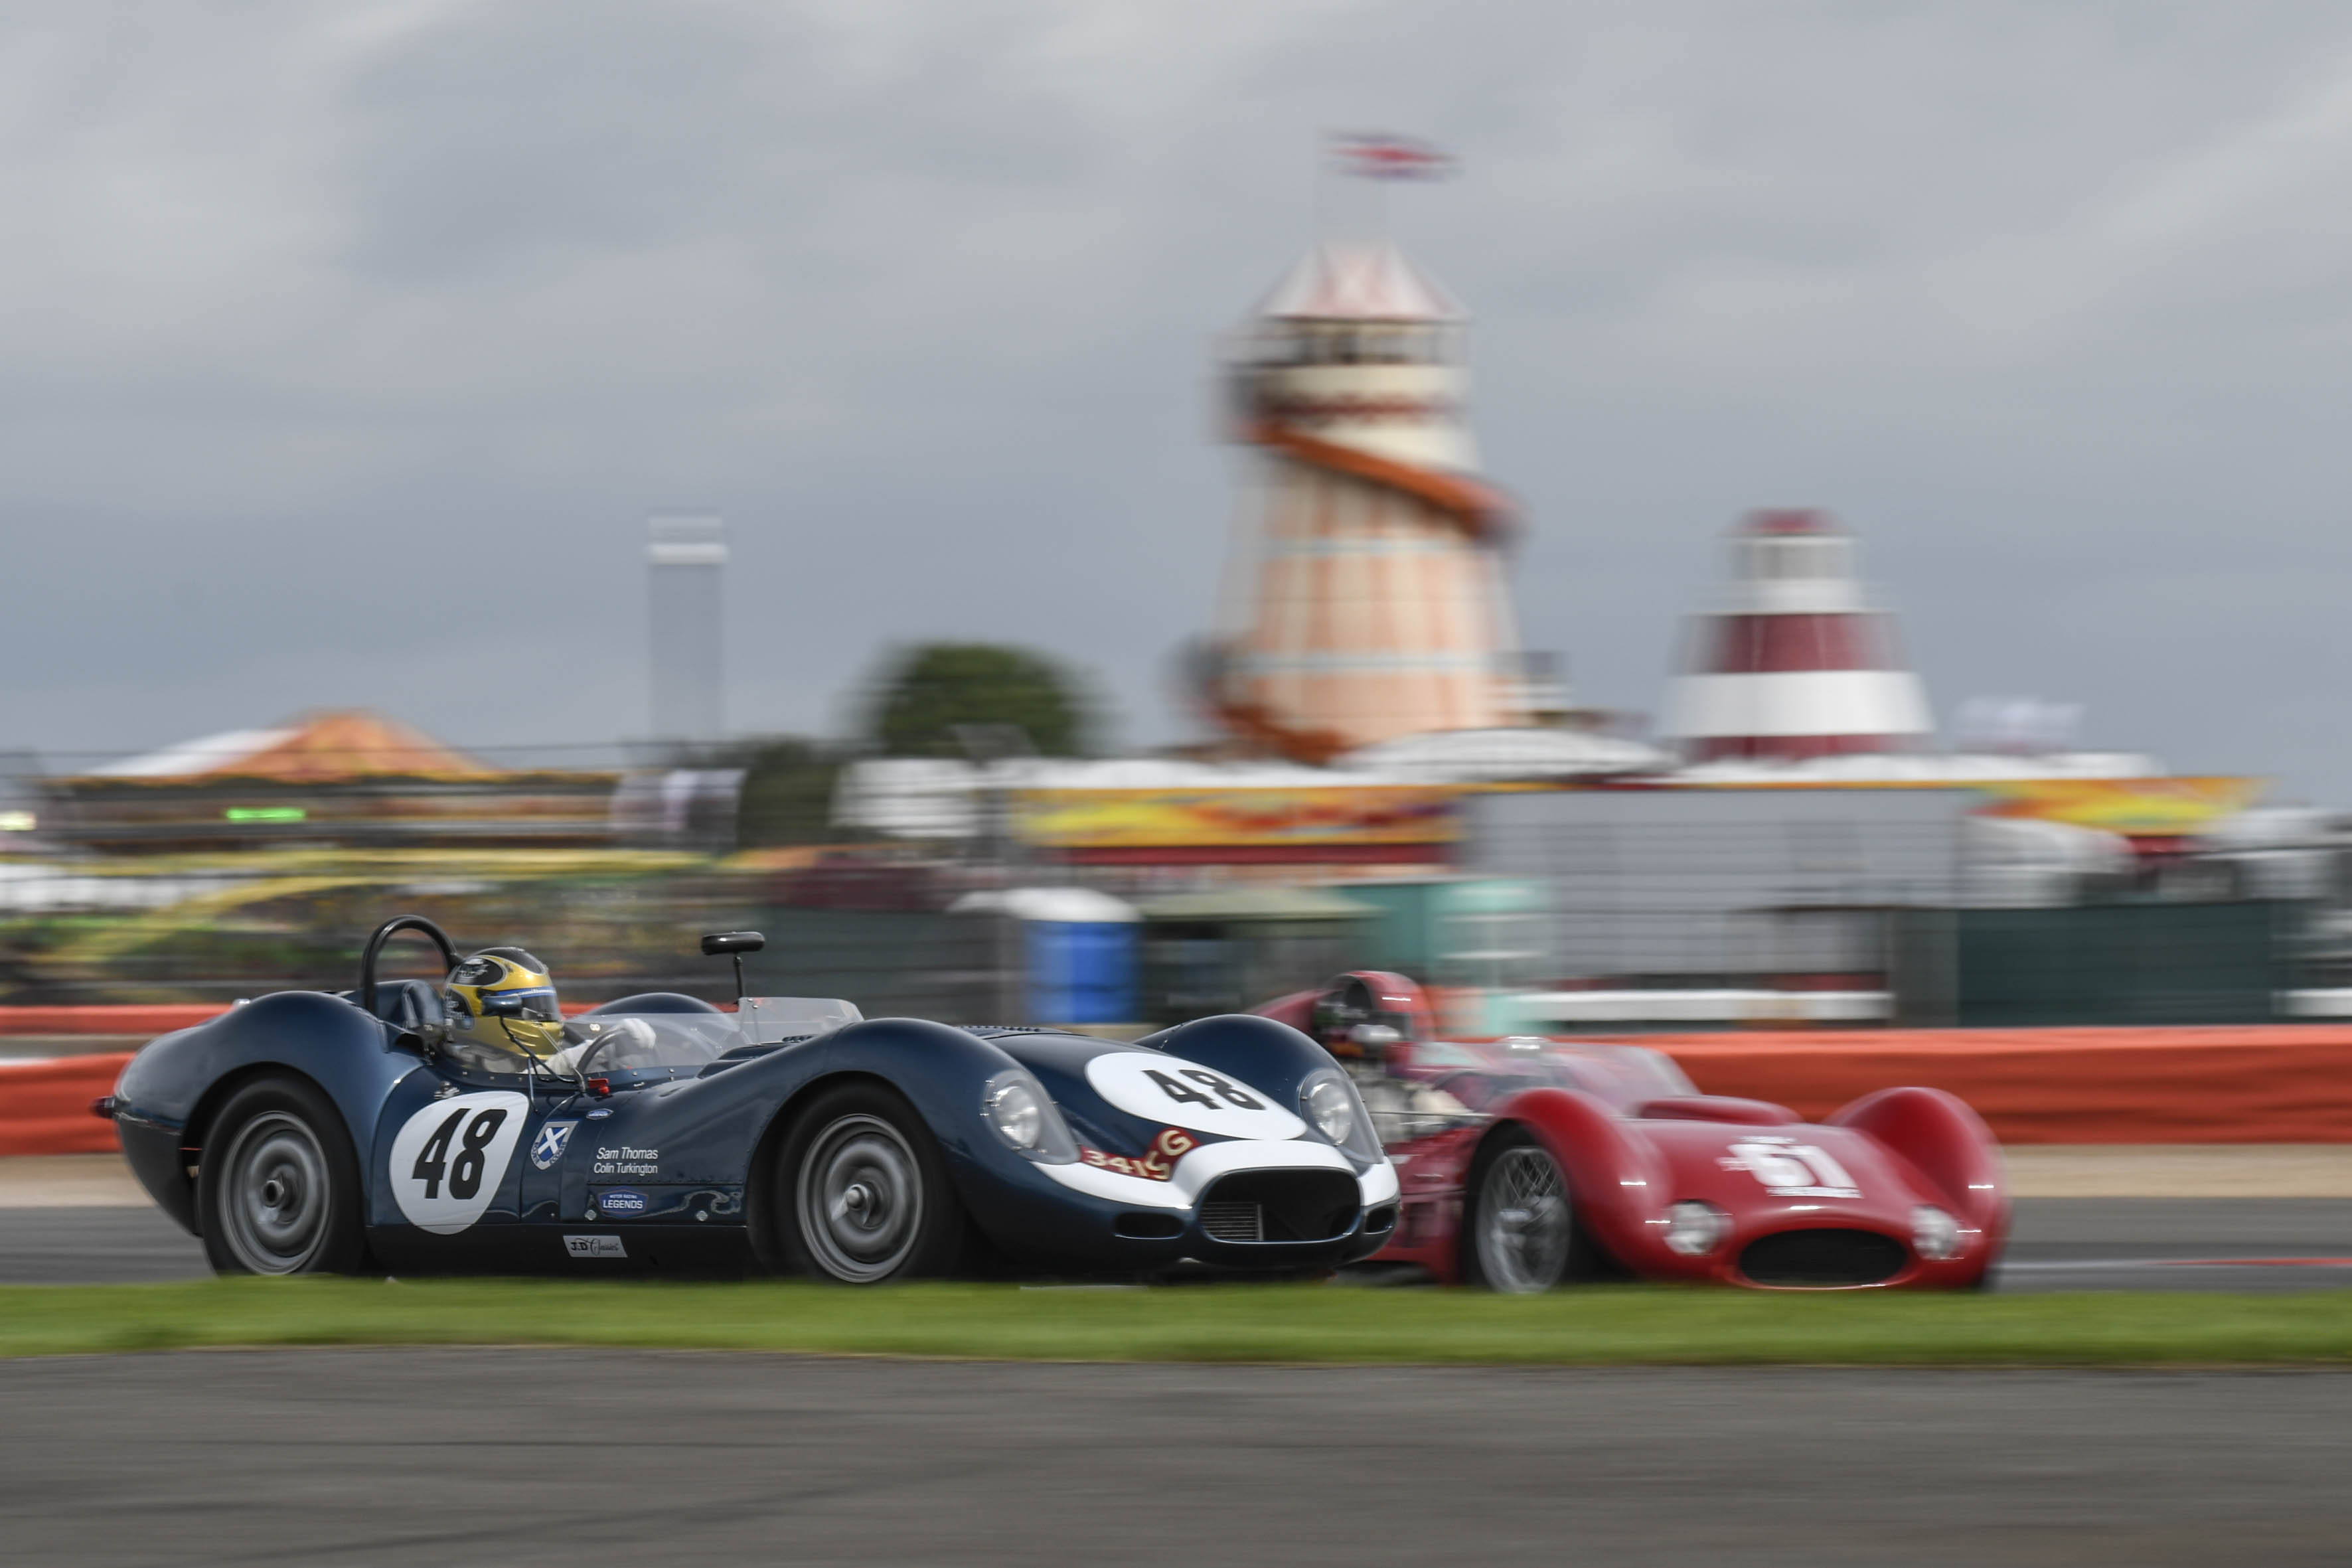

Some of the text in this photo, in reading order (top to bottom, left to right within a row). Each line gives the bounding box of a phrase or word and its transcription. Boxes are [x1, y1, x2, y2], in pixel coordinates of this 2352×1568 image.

[1140, 1069, 1267, 1111] 48
[412, 1108, 508, 1200] 48
[597, 1146, 659, 1160] Sam Thomas
[593, 1162, 658, 1176] Colin Turkington
[603, 1200, 643, 1209] LEGENDS
